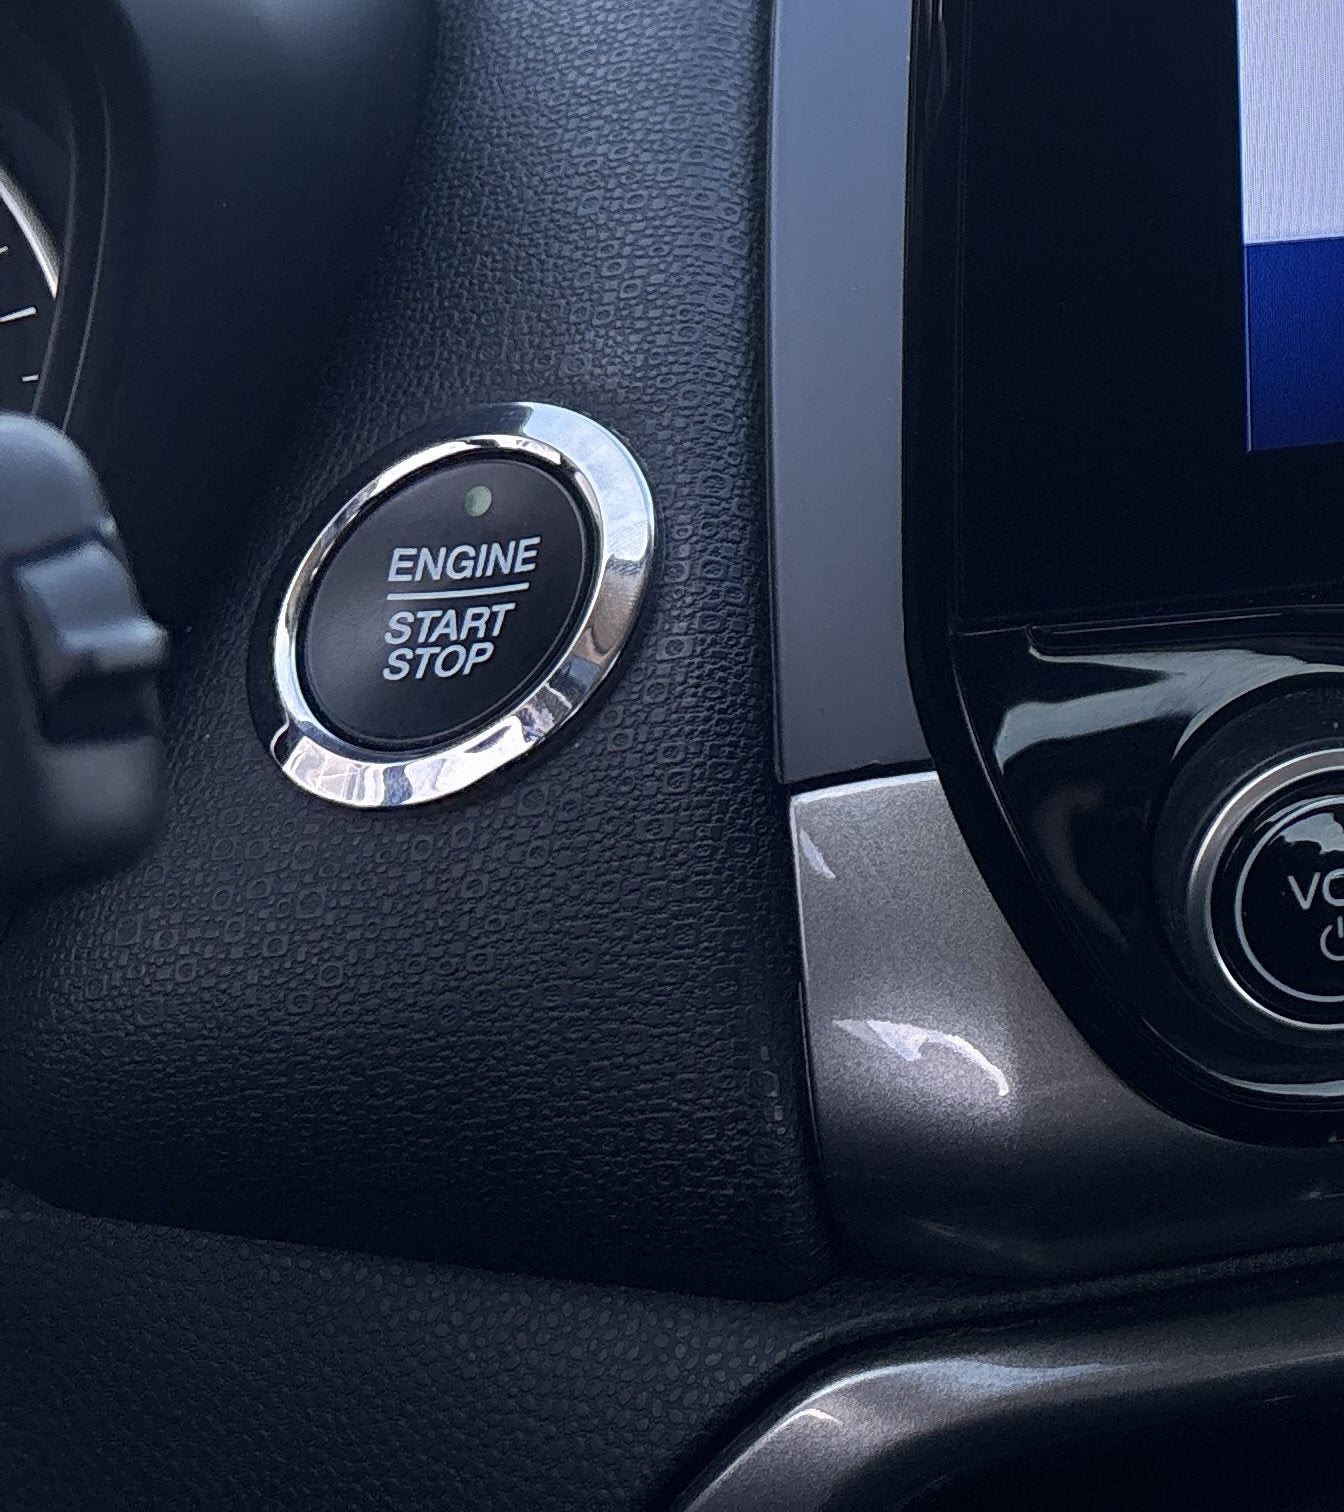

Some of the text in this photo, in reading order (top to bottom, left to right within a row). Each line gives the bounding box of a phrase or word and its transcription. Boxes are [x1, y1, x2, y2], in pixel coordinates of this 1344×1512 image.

[387, 536, 542, 583] ENGINE
[384, 603, 517, 645] START
[382, 642, 495, 682] STOP
